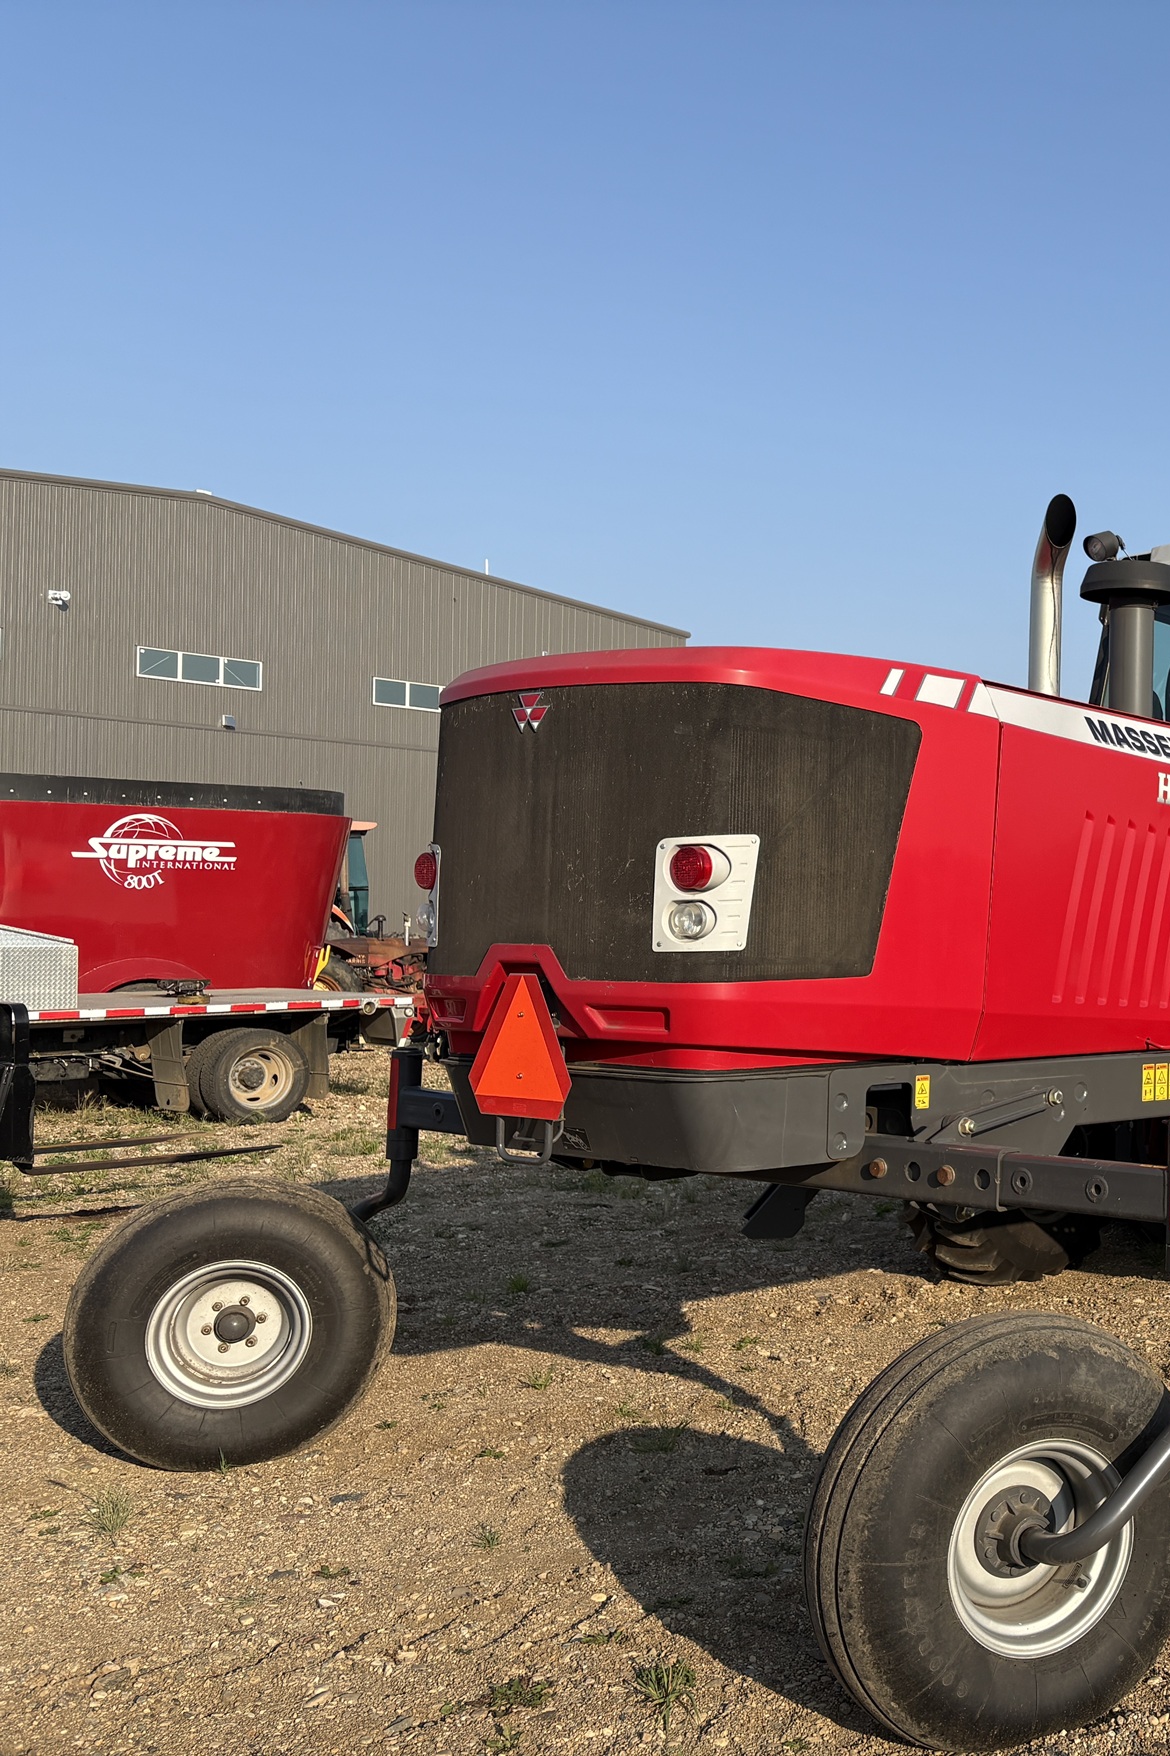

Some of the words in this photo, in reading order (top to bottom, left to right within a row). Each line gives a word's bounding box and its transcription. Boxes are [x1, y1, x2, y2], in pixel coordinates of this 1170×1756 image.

[71, 837, 237, 868] Supreme
[136, 860, 236, 871] INTERNATIONAL
[124, 869, 165, 890] 800T
